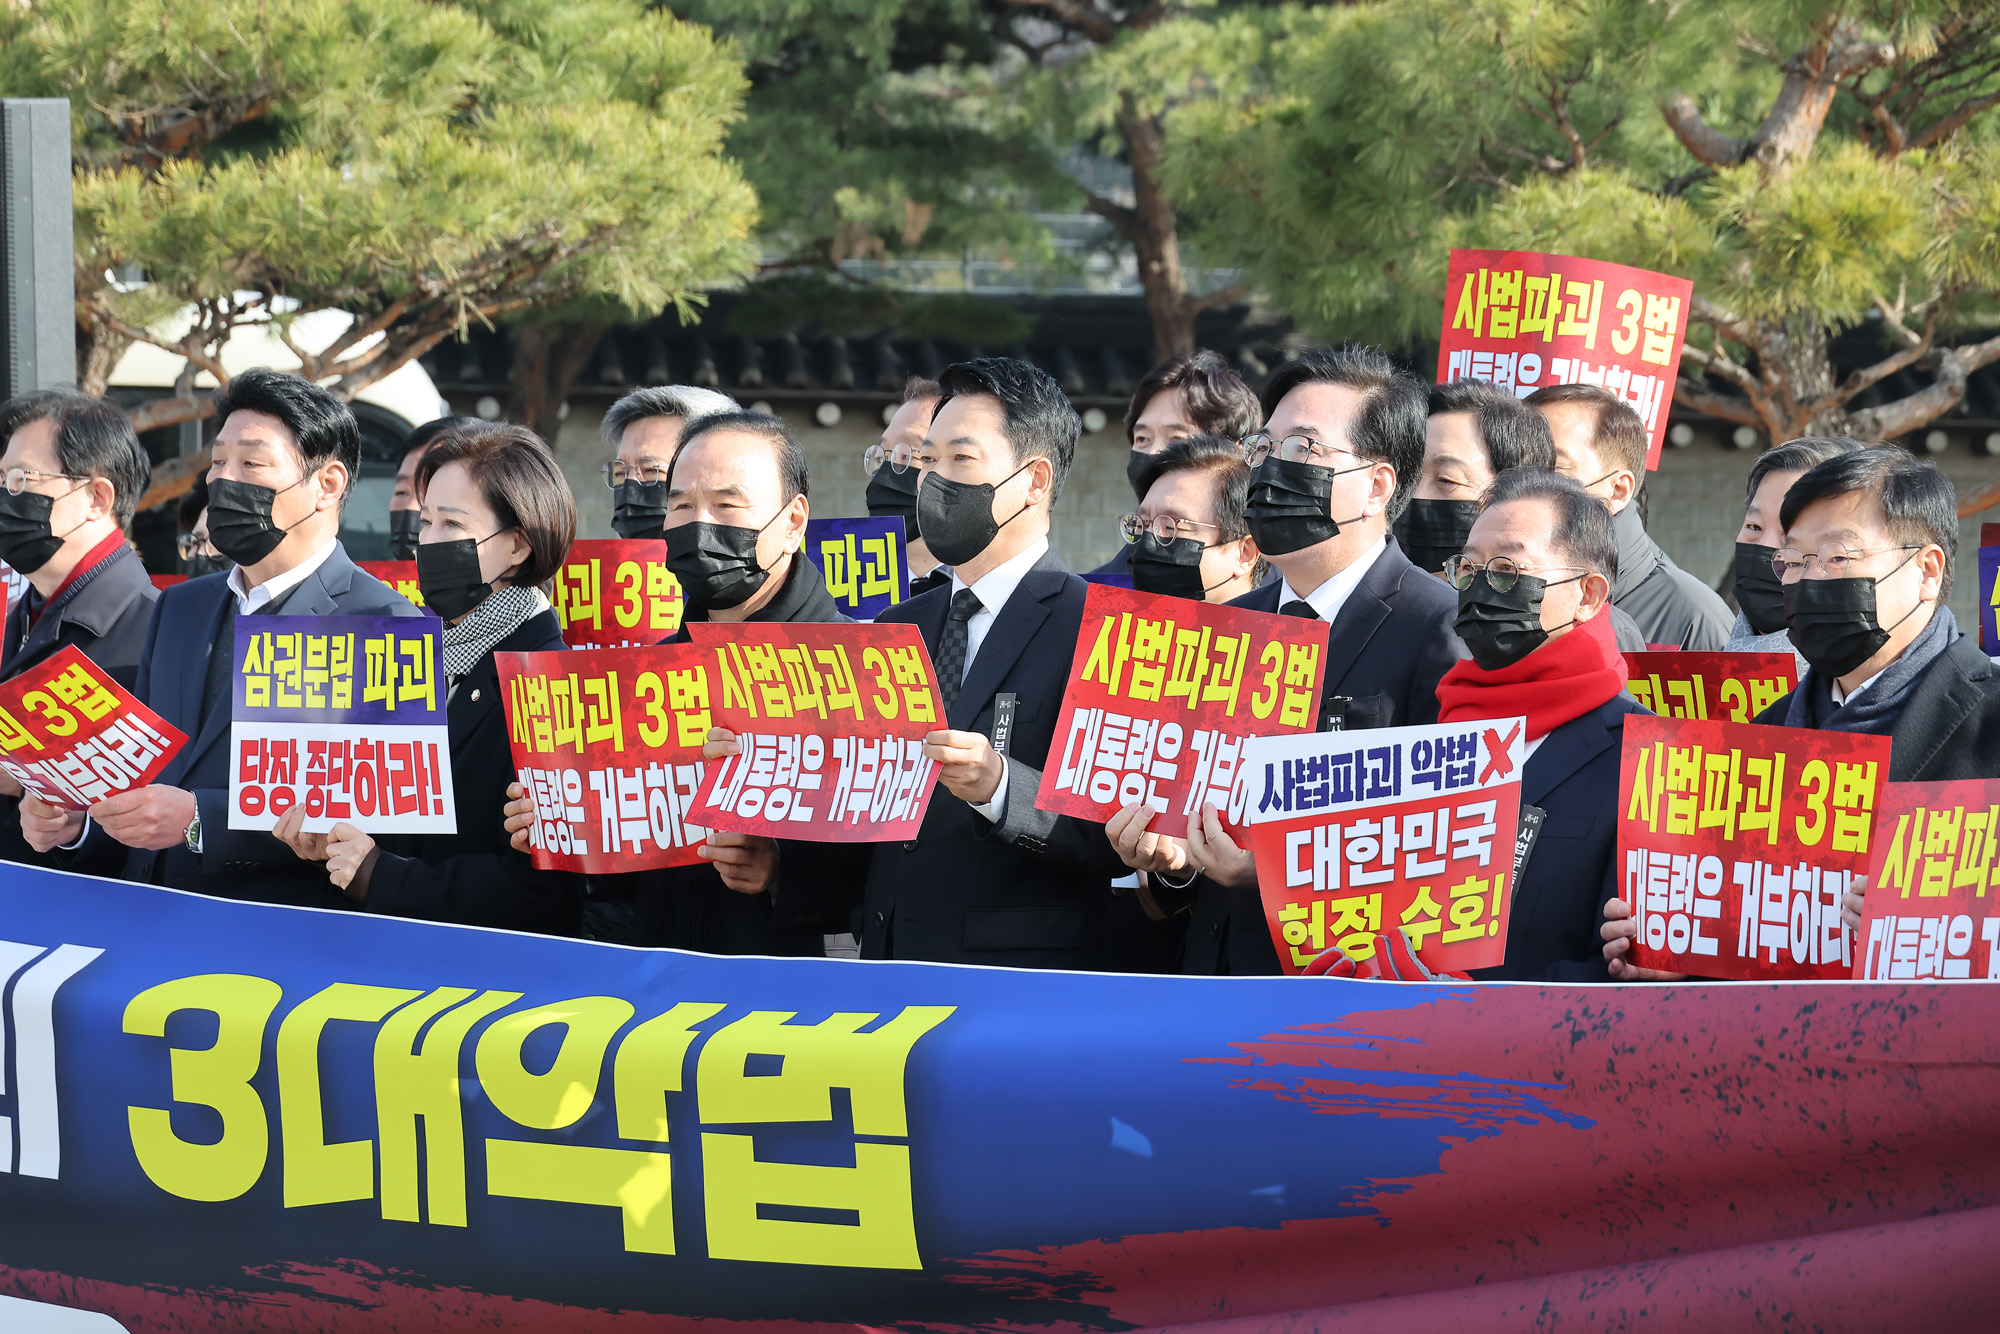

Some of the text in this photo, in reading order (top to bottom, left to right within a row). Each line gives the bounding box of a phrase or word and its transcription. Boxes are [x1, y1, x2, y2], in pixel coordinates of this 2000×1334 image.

[1451, 268, 1681, 366] 사법파괴 3법
[614, 560, 684, 630] 3법
[821, 532, 900, 606] 파괴
[22, 662, 122, 737] 3법
[241, 632, 436, 712] 삼권분립 파괴
[510, 665, 714, 754] 사법파괴 3법
[715, 642, 937, 723] 사법파괴 3법
[1080, 611, 1320, 728] 사법파괴 3법
[24, 711, 172, 806] 거부하라!
[239, 737, 444, 818] 당장 중단하라!
[705, 732, 932, 825] 대통령은 거부하라!
[1054, 707, 1184, 814] 대통령은
[1258, 732, 1478, 813] 사법파괴 악법
[1626, 741, 1878, 853] 사법파괴 3법
[1286, 799, 1498, 892] 대한민국
[1877, 804, 2000, 899] 사법파
[1278, 872, 1505, 967] 헌정 수호!
[1625, 848, 1724, 956] 대통령은
[122, 973, 957, 1270] 3대악법
